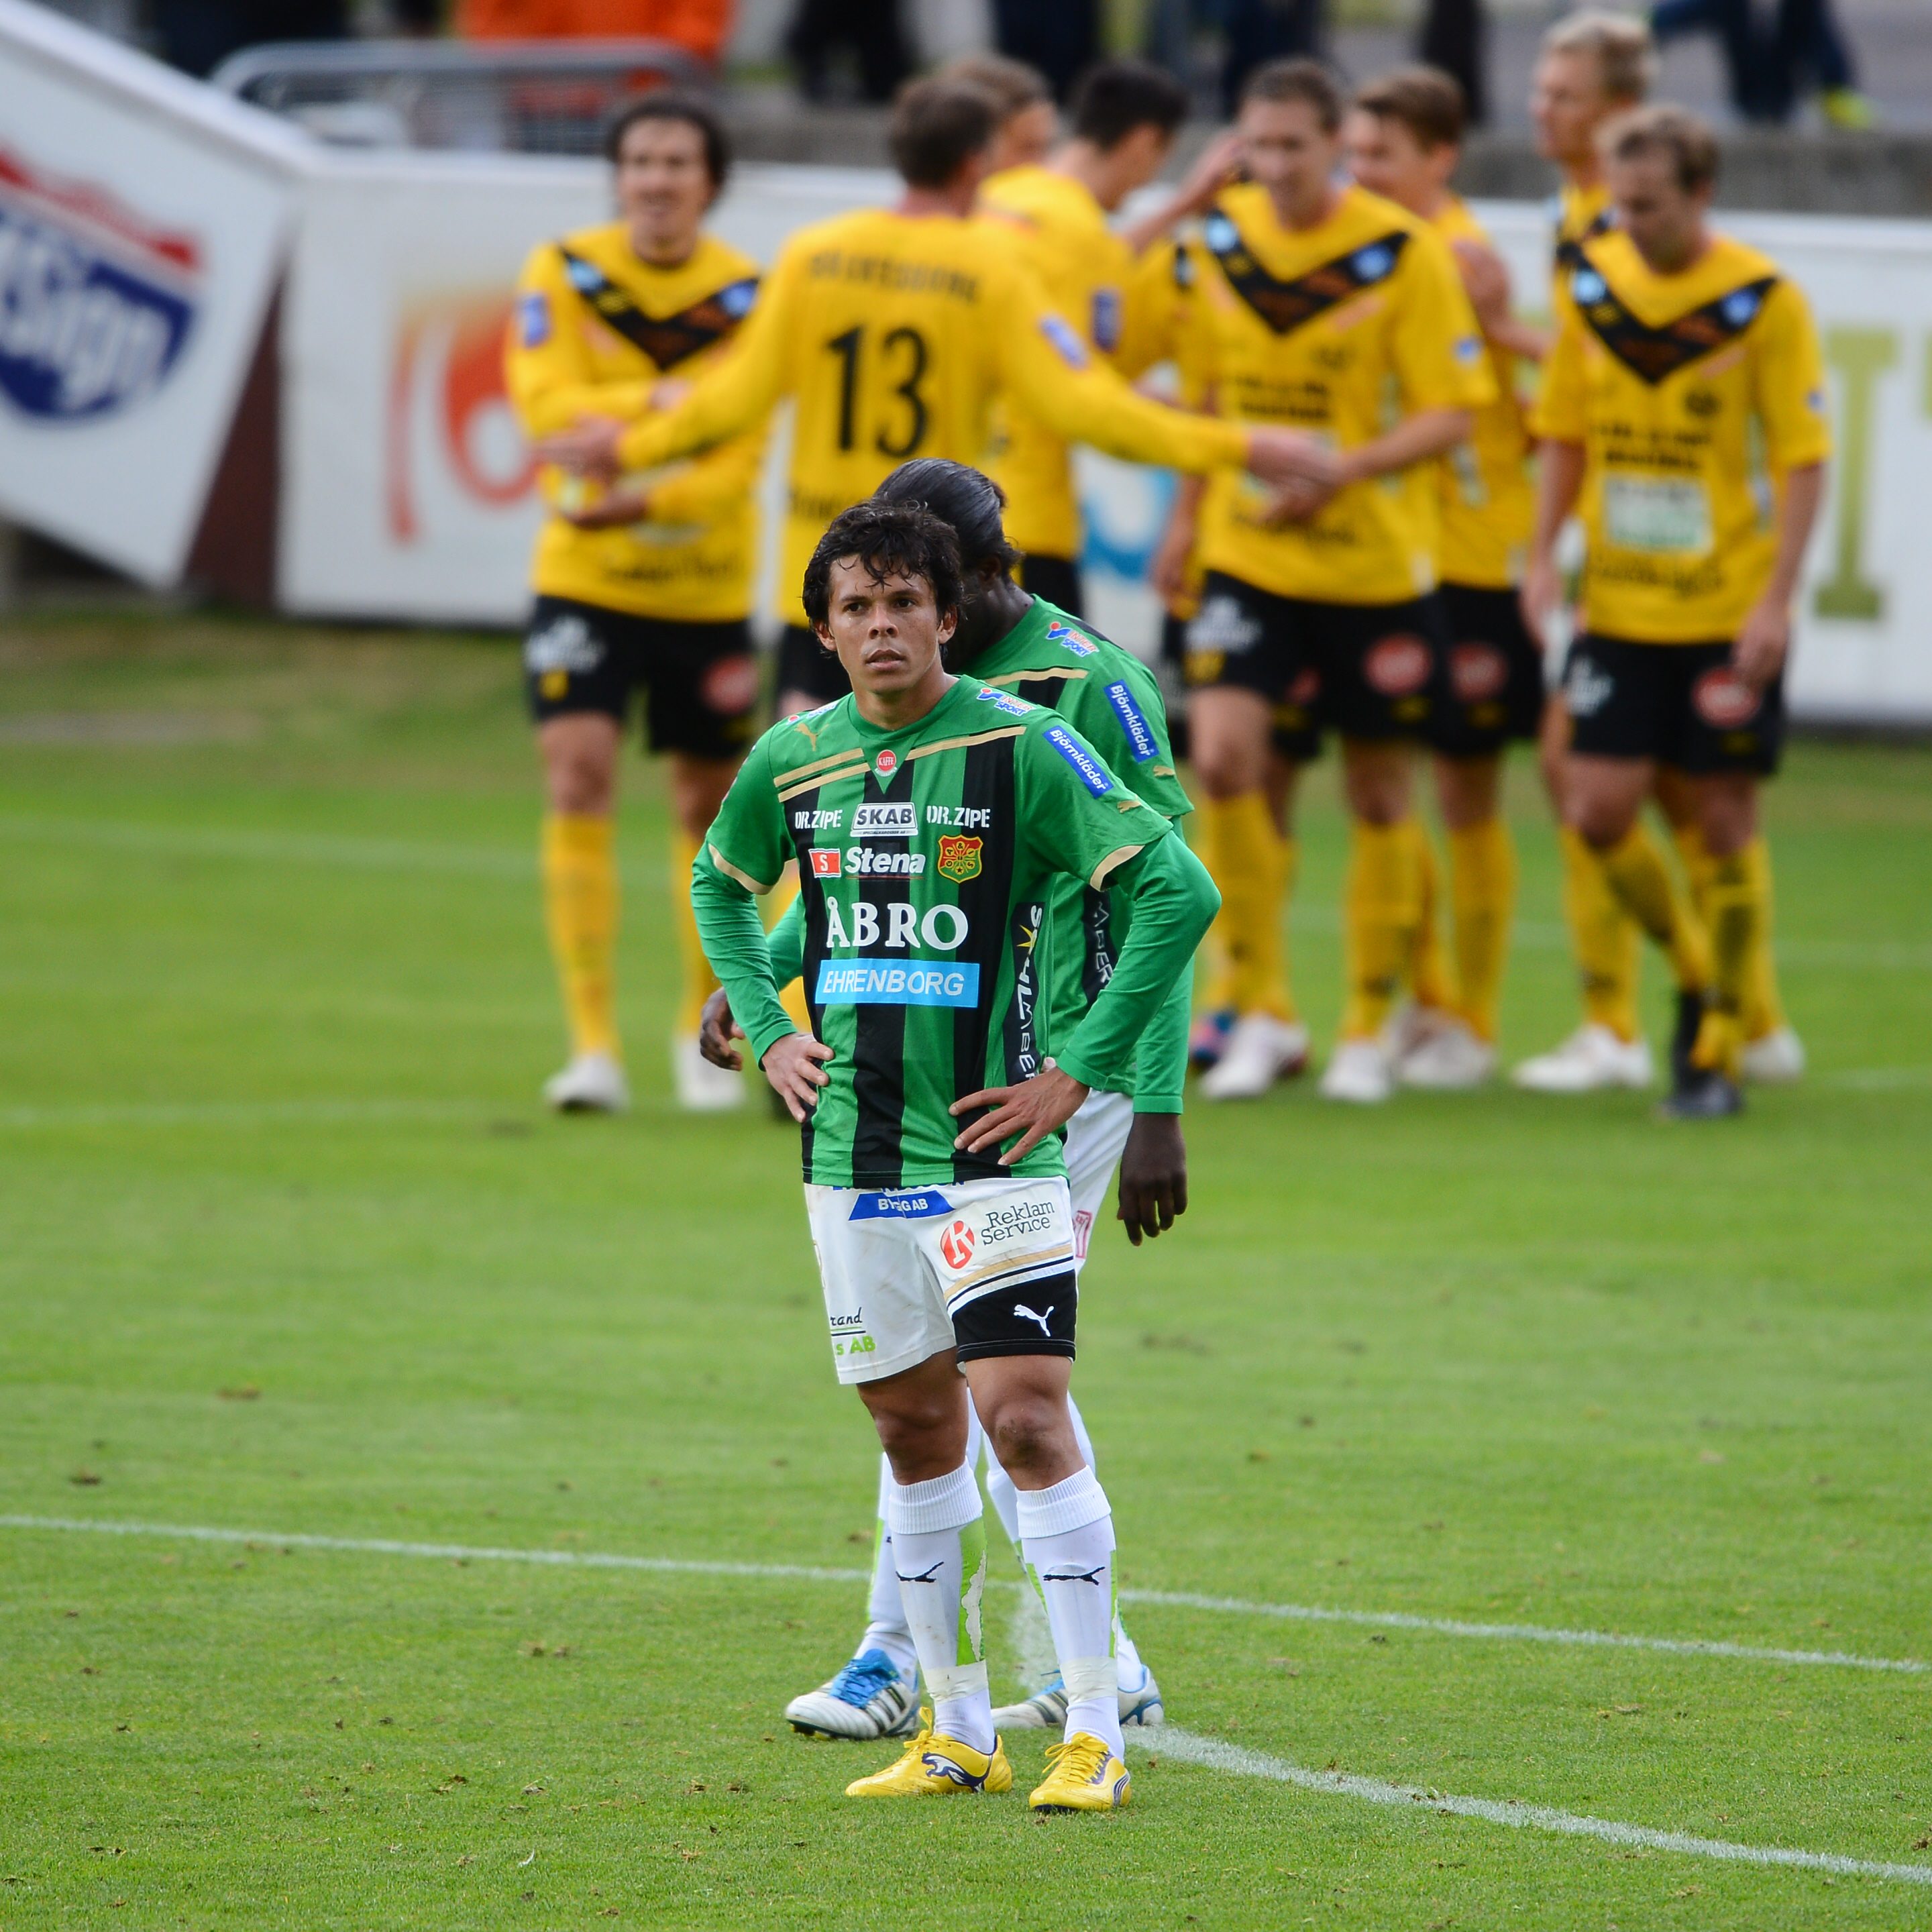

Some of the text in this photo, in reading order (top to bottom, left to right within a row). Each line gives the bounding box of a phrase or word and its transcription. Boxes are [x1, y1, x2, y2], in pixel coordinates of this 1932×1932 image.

[827, 323, 929, 459] 13
[1062, 638, 1090, 656] SPORT
[996, 701, 1028, 716] SPORT
[1110, 684, 1151, 757] Björnkläder
[1049, 729, 1107, 790] Björnkläder
[856, 808, 913, 826] SKAB
[844, 846, 926, 874] Stena
[826, 896, 969, 951] ÅBRO
[822, 969, 965, 996] EHRENBORG
[985, 1201, 1055, 1229] Reklam
[980, 1216, 1051, 1246] Service
[850, 1336, 876, 1354] AB
